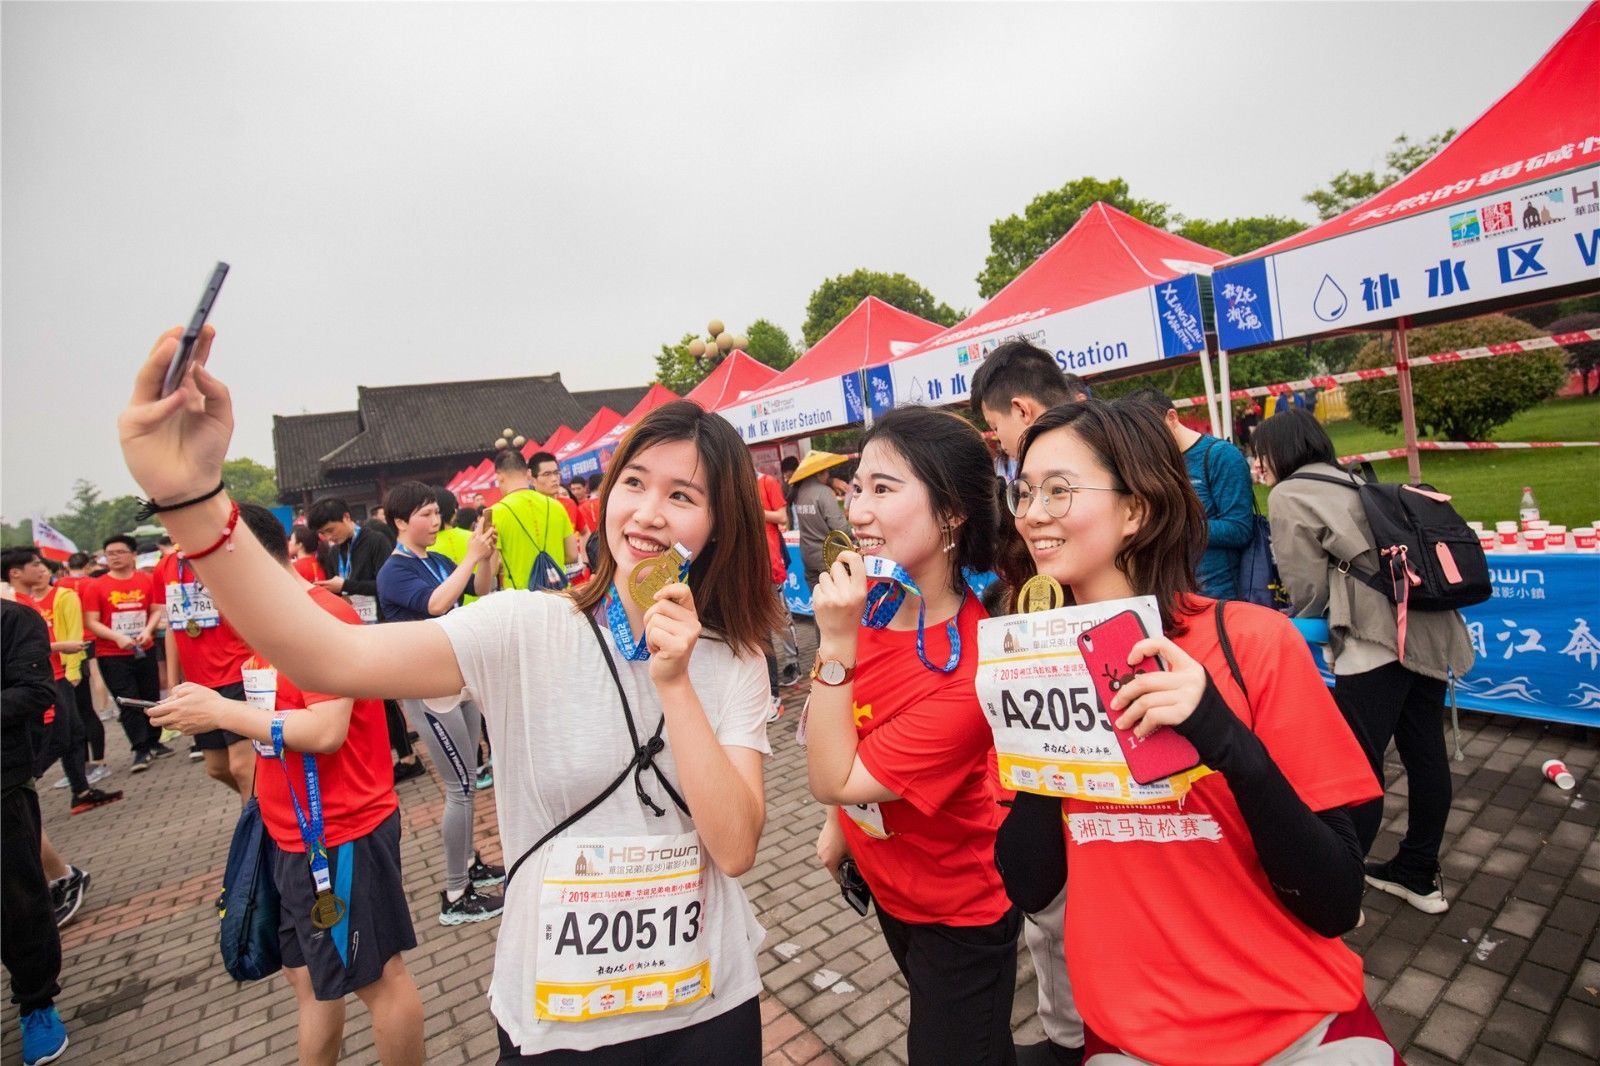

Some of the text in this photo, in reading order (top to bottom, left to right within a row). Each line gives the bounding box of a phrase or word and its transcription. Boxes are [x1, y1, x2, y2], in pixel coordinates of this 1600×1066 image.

[1056, 341, 1128, 371] Station
[773, 408, 832, 433] Water Station
[1077, 817, 1200, 839] 湘江马拉松赛
[554, 900, 701, 956] A20513
